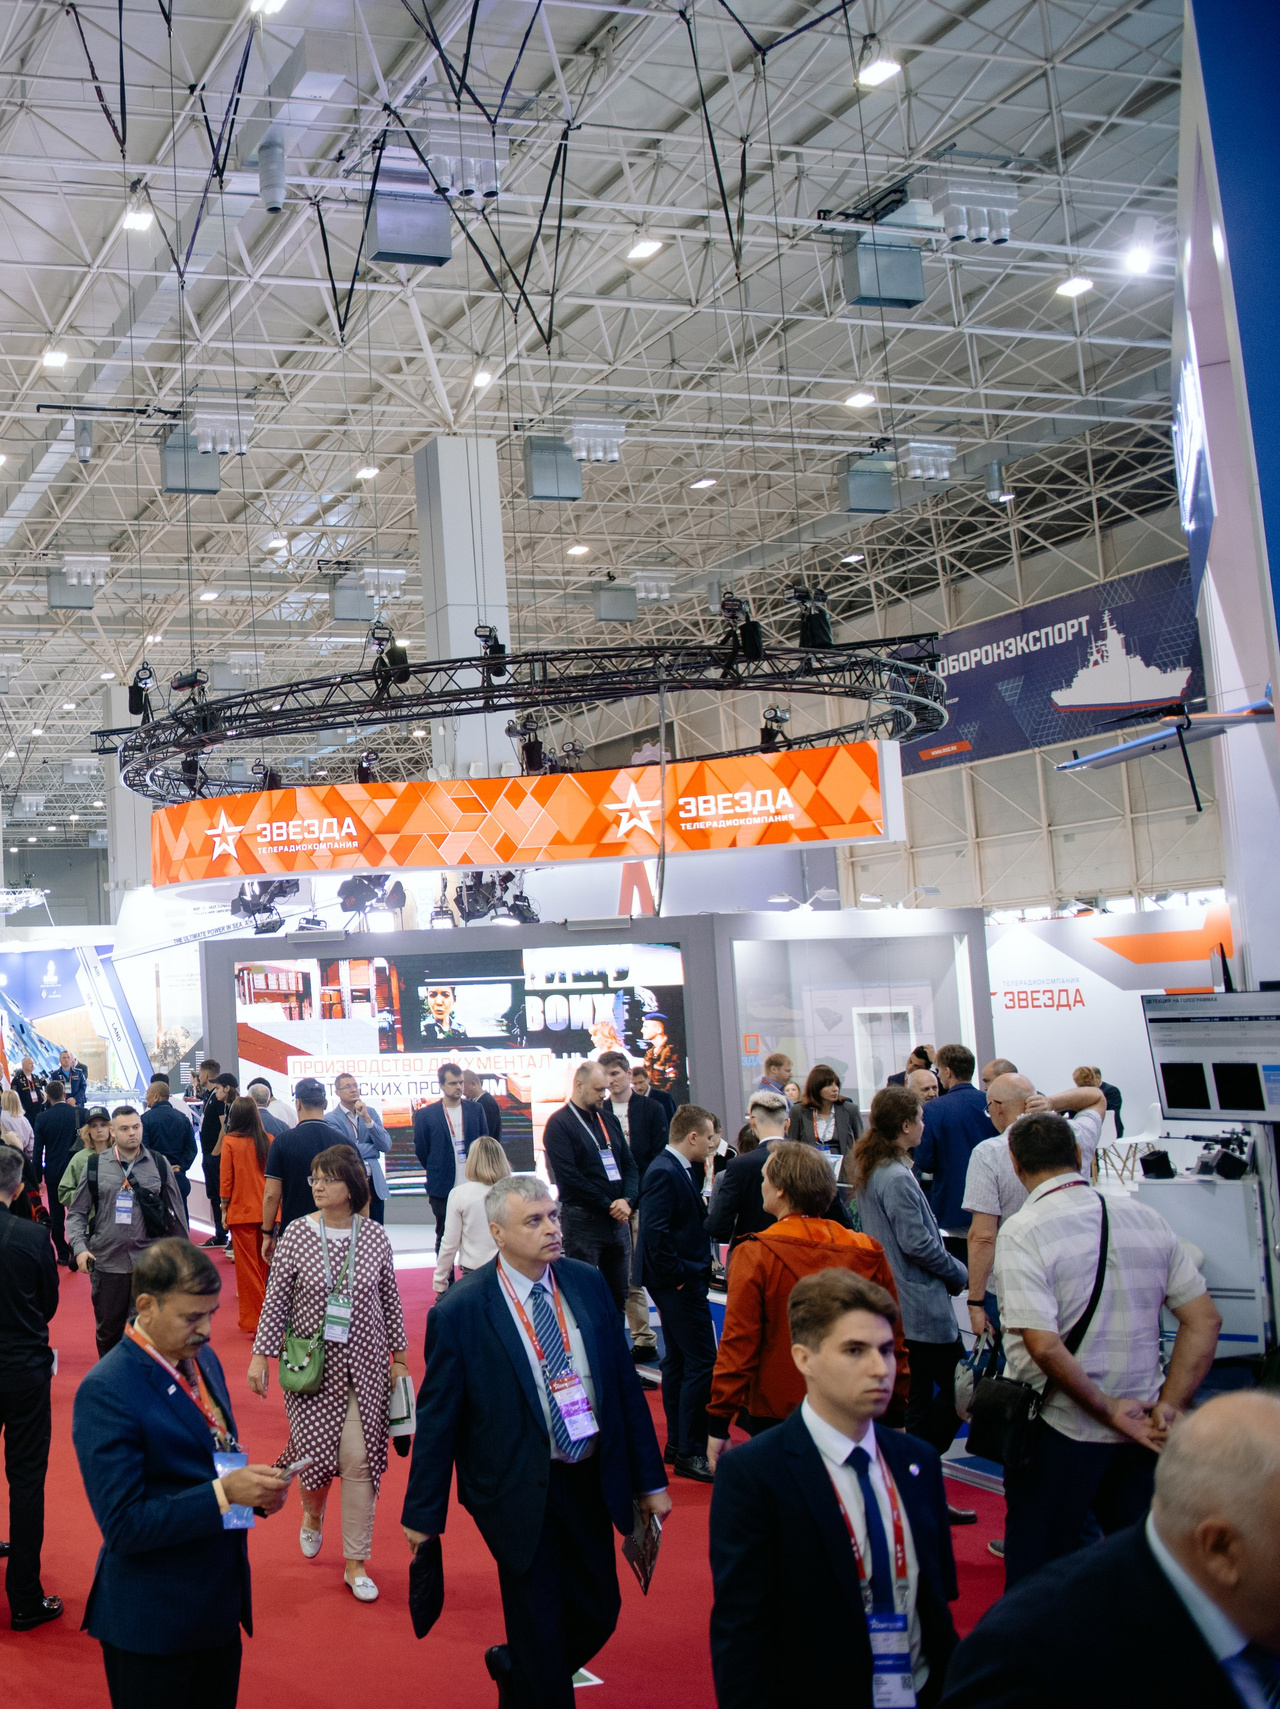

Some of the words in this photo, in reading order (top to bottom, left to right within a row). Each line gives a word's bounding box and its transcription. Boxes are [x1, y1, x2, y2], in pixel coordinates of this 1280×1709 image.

[937, 615, 1090, 678] ОБОРОНЭКСПОРТ
[677, 788, 794, 818] ЗВЕЗДА
[256, 816, 358, 843] ЗВЕЗДА
[679, 814, 795, 831] ТЕЛЕРАДИОКОМПАНИЯ
[256, 840, 359, 855] ТЕЛЕРАДИОКОМПАНИЯ
[183, 931, 207, 943] ULTIMATE
[207, 926, 226, 937] POWER
[93, 965, 101, 978] AIR
[1002, 977, 1080, 987] ТЕЛЕРАДИОКОМПАНИЯ
[85, 992, 94, 1008] SEA
[1003, 988, 1086, 1011] ЗВЕЗДА
[111, 1022, 122, 1043] LAND
[292, 1057, 424, 1075] ПРОИЗВОДСТВО
[428, 1052, 552, 1073] ДОКУМЕНТАЛ
